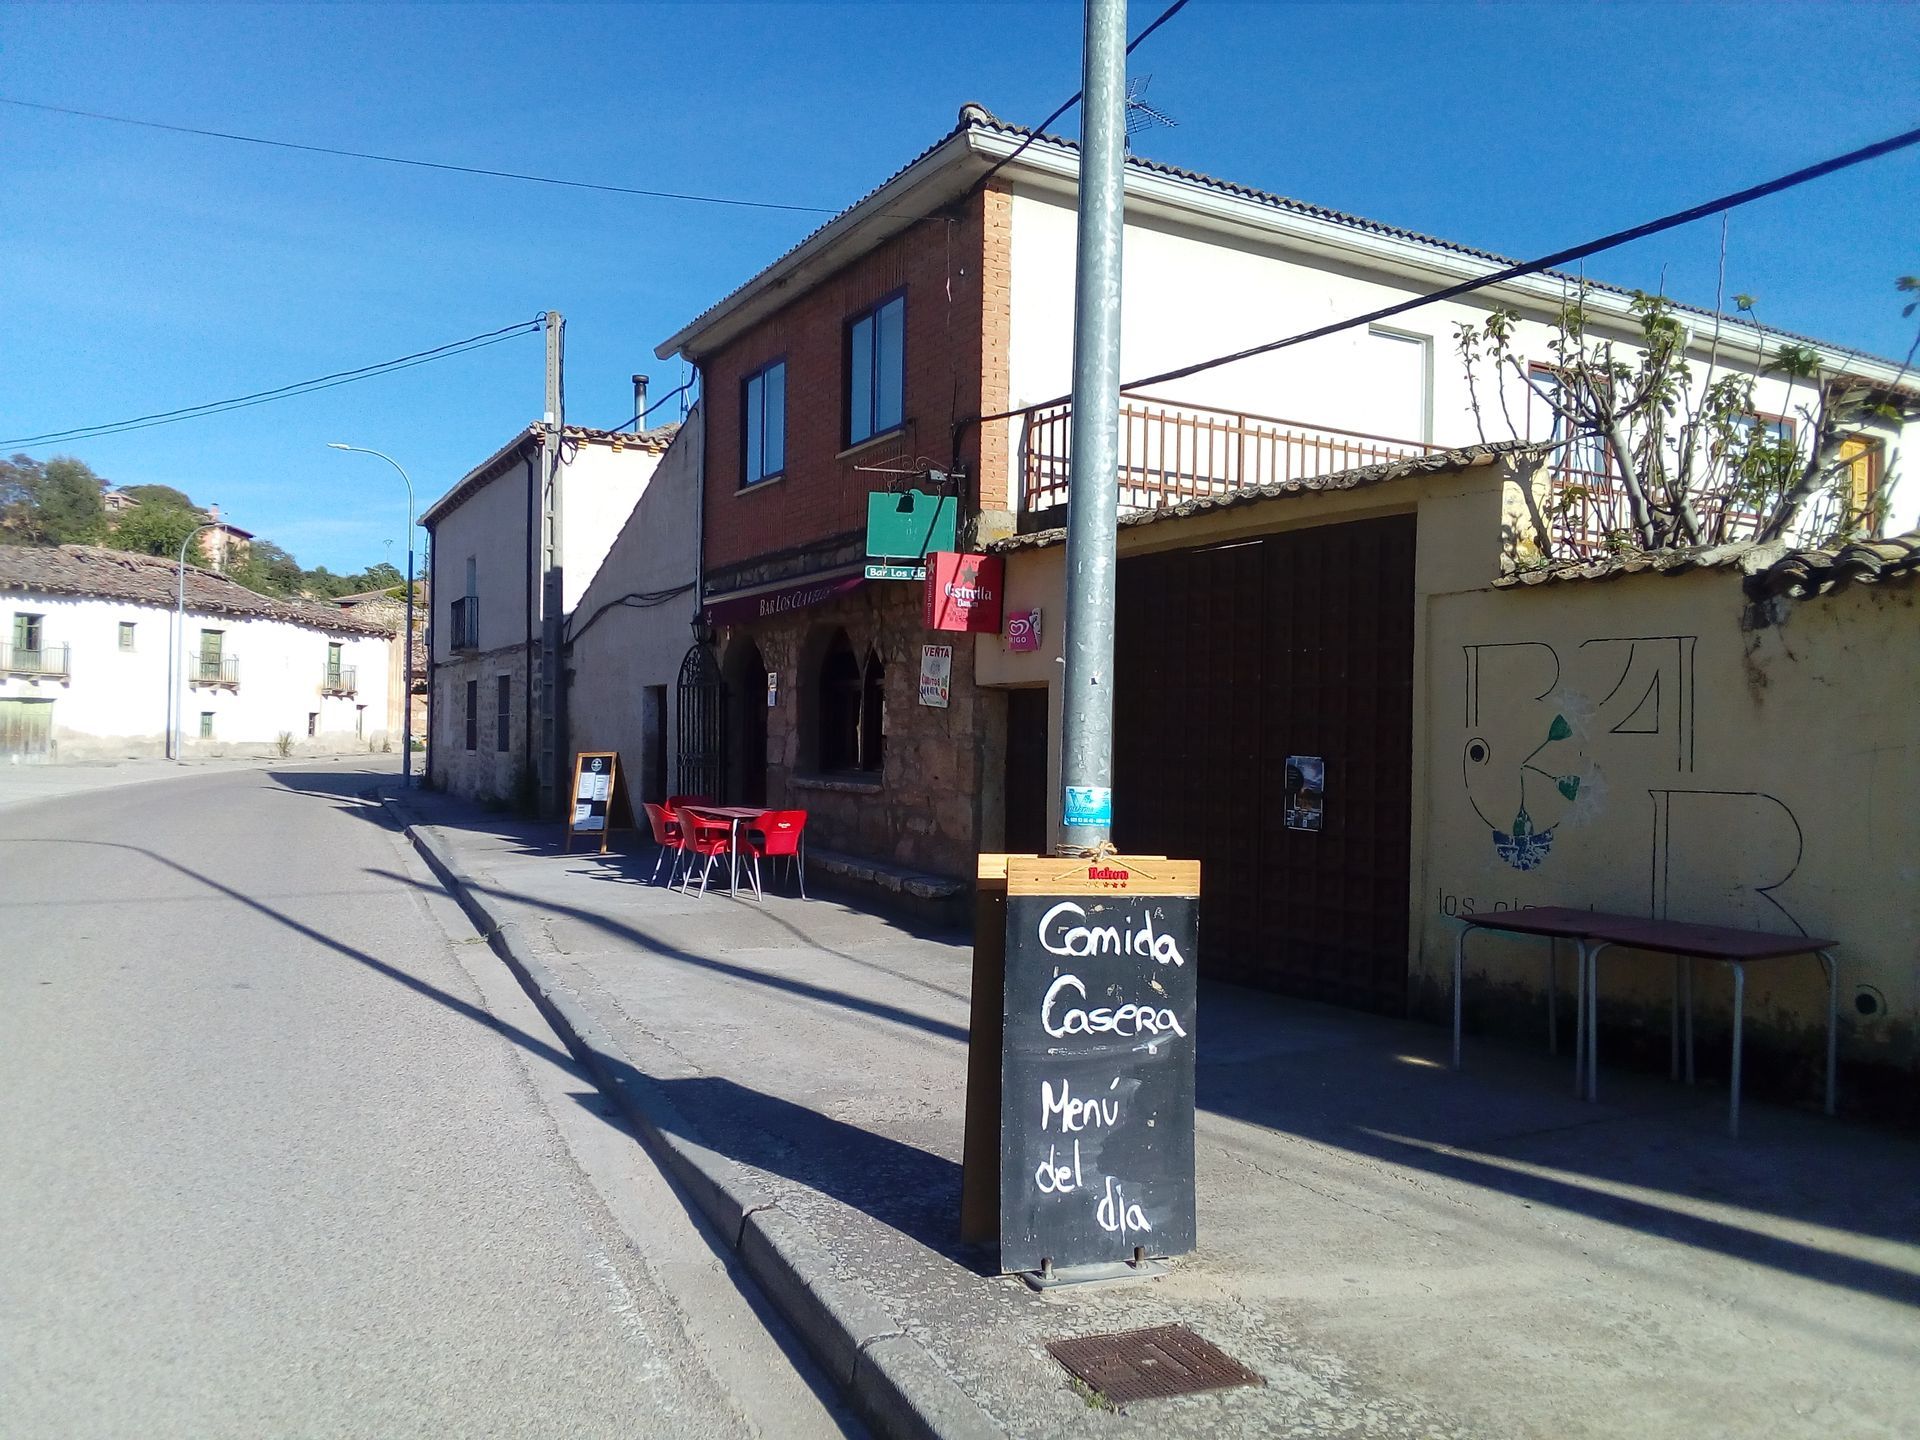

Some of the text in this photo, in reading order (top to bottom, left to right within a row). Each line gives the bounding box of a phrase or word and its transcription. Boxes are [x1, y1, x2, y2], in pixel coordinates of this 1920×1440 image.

[869, 567, 887, 577] Bar
[891, 568, 908, 578] Los
[760, 599, 775, 616] BAR
[776, 595, 791, 613] LOS
[1038, 901, 1185, 968] Comida
[1041, 973, 1188, 1039] Casera
[1041, 1077, 1120, 1133] Menú
[1035, 1139, 1082, 1193] del
